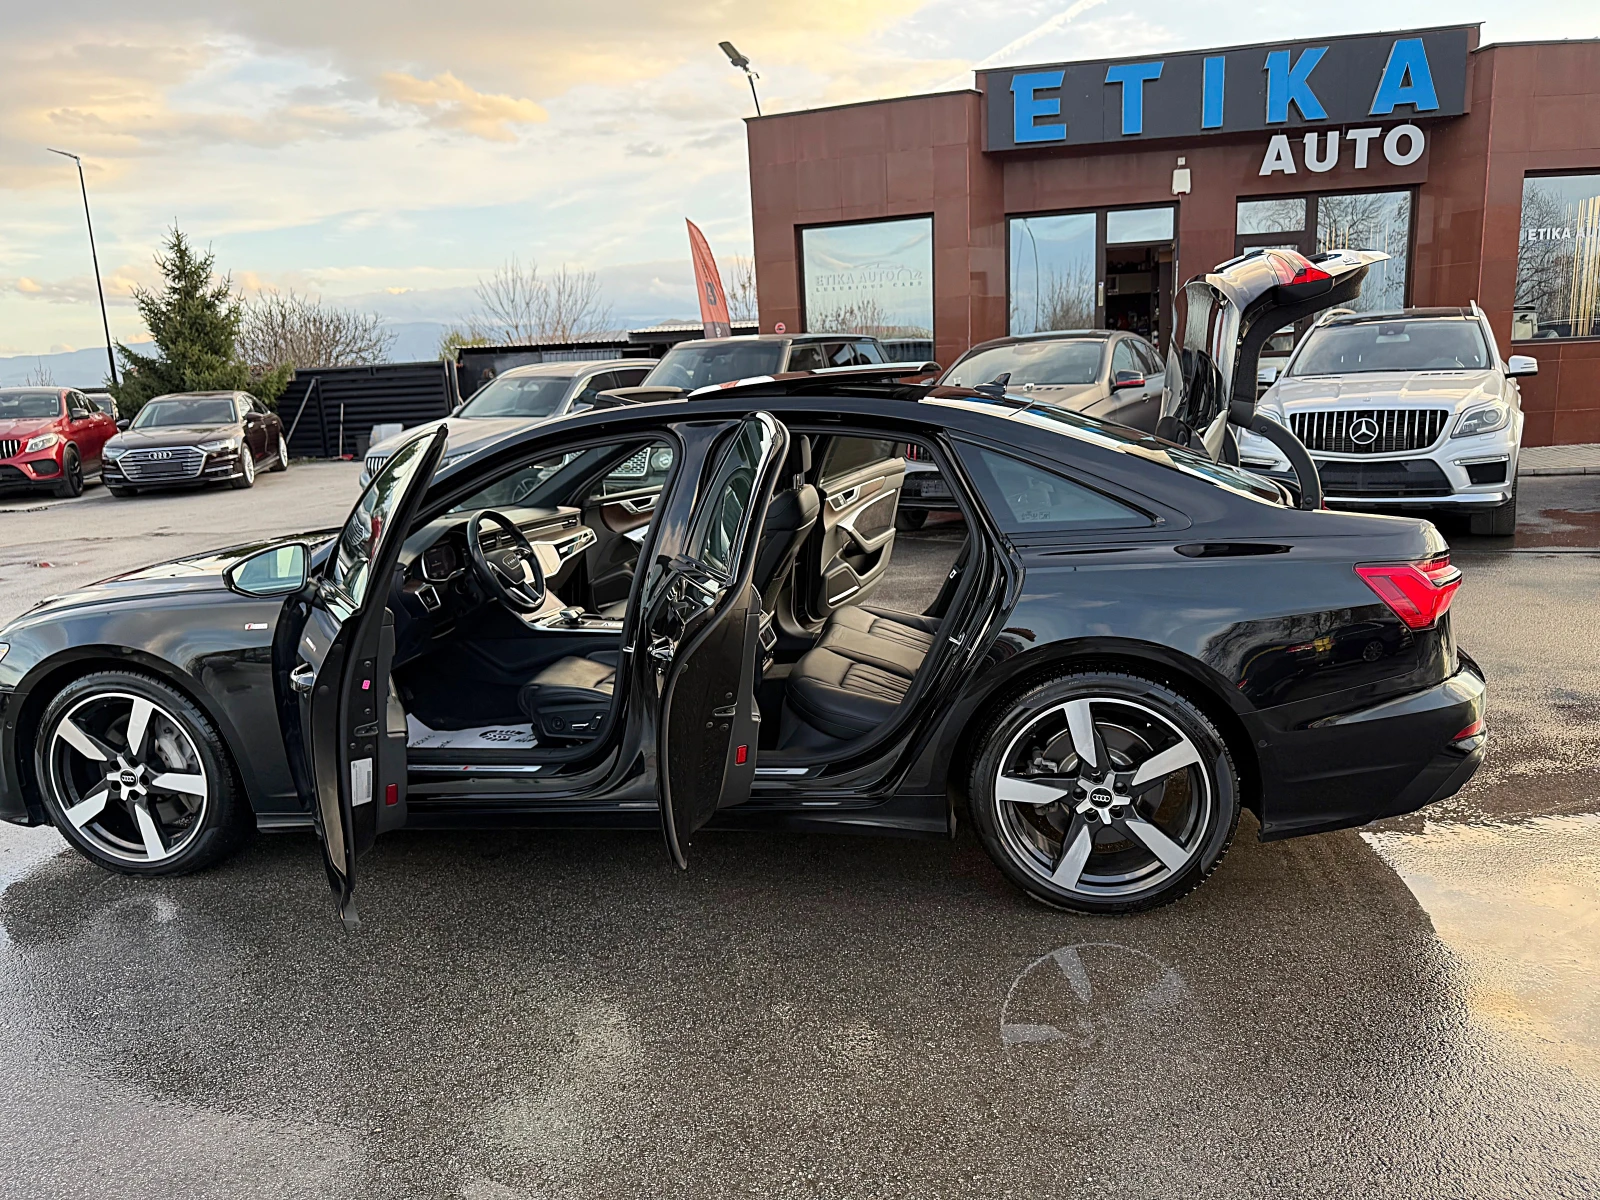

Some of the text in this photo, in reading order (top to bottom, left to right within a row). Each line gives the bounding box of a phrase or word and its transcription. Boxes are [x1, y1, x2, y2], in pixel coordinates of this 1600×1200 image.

[1010, 37, 1440, 144] ETIKA
[1258, 124, 1426, 176] AUTO
[1528, 226, 1600, 240] ETIKA AU
[816, 273, 855, 286] ETIKA
